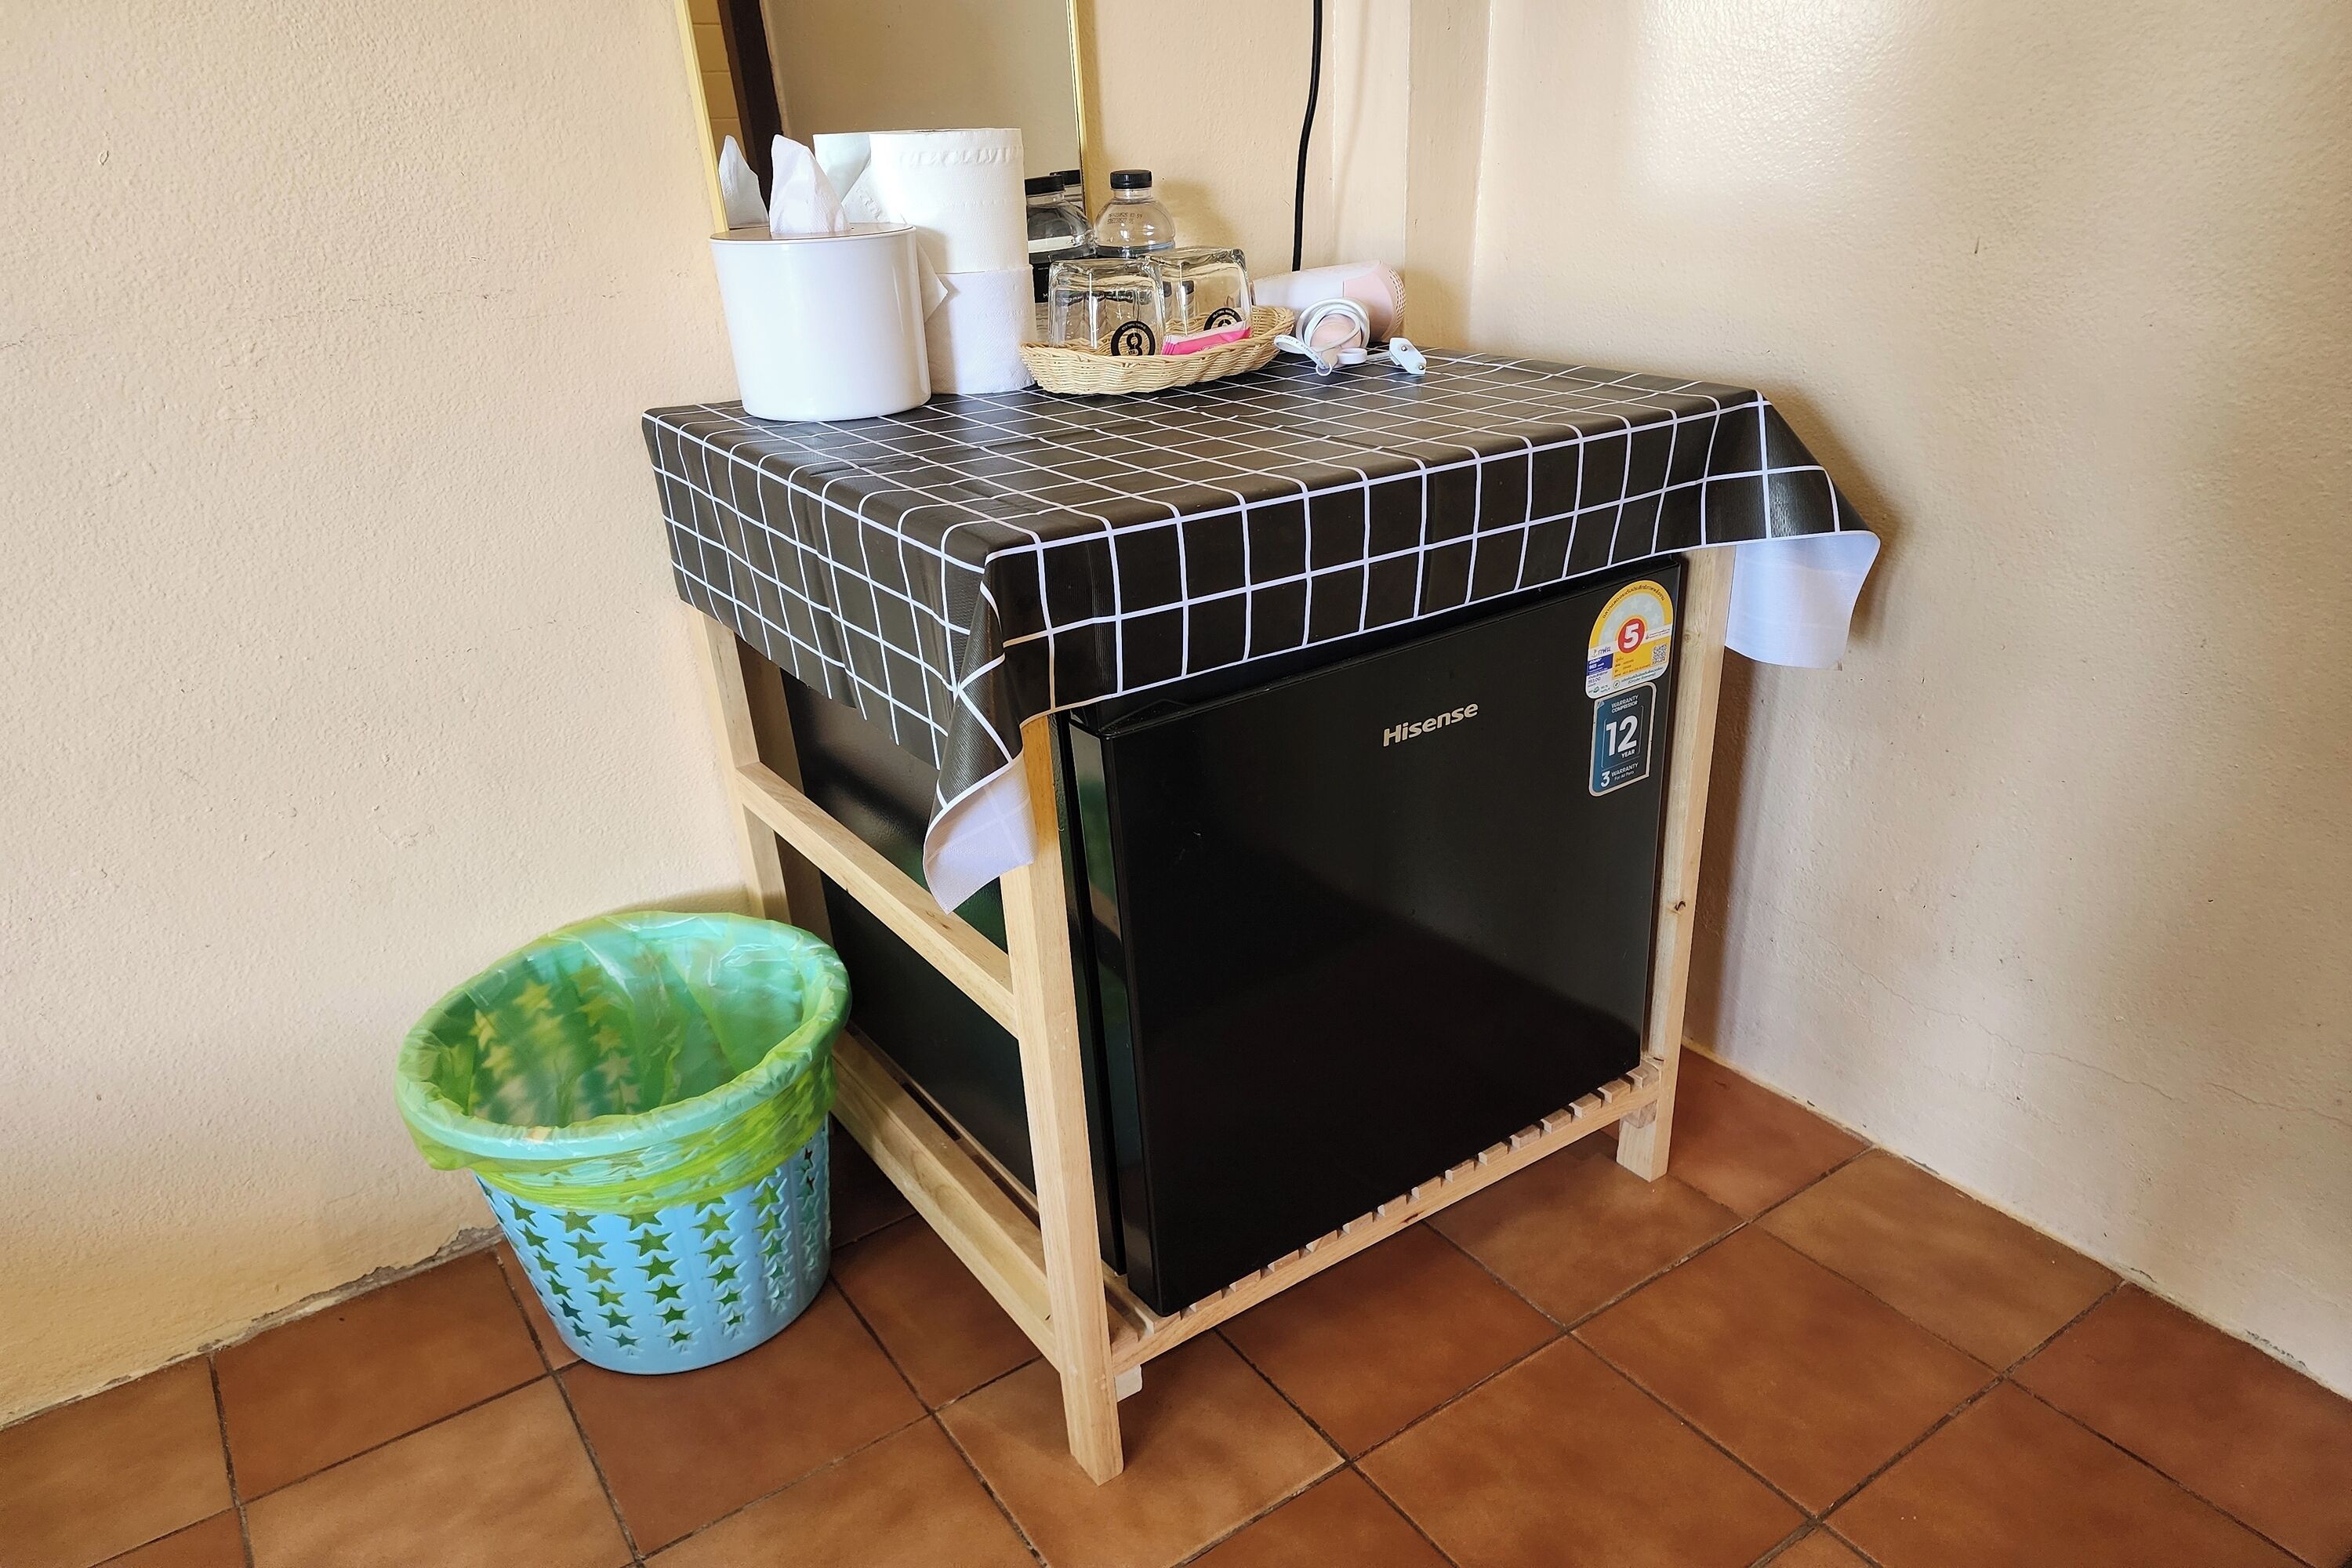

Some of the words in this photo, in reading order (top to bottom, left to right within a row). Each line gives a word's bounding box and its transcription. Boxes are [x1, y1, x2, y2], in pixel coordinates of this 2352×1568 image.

[1623, 622, 1639, 649] 5
[1611, 694, 1639, 709] WARRANTY
[1611, 700, 1638, 713] COMPRESSOR
[1383, 703, 1479, 747] Hisense
[1606, 715, 1638, 757] 12
[1621, 749, 1635, 758] YEAR
[1611, 762, 1639, 777] WARRANTY
[1600, 770, 1610, 787] 3
